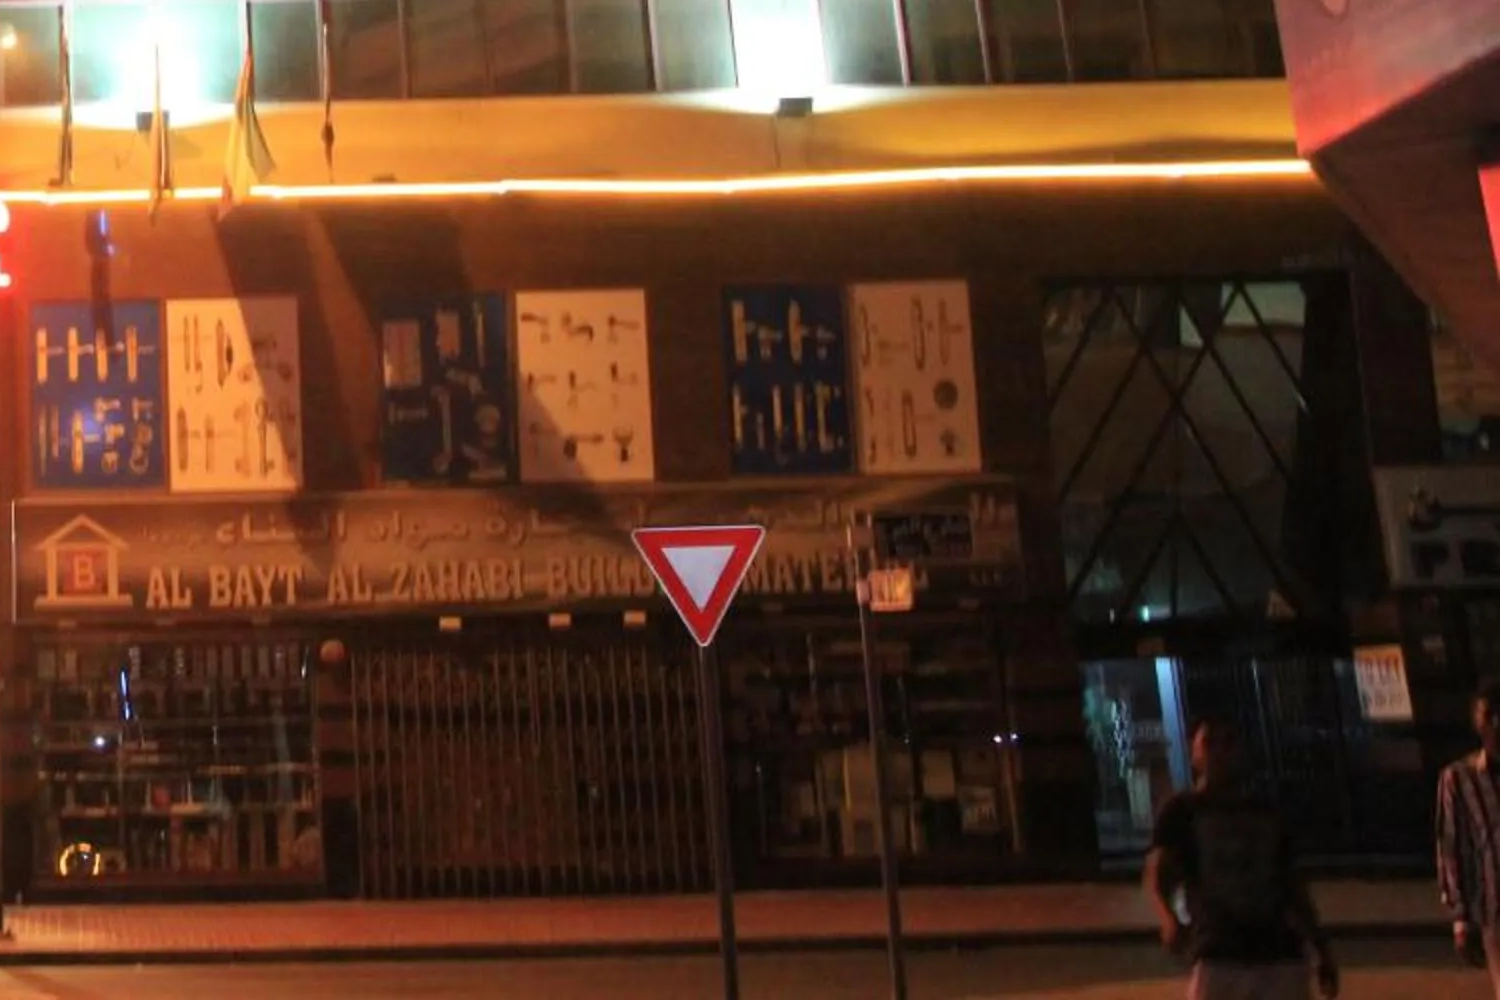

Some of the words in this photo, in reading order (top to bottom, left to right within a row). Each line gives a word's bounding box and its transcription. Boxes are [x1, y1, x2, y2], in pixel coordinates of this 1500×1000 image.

[74, 556, 96, 590] B
[146, 567, 192, 609] AL
[209, 564, 304, 607] BAYT
[327, 561, 372, 603] AL
[387, 557, 525, 602] ZAHABI
